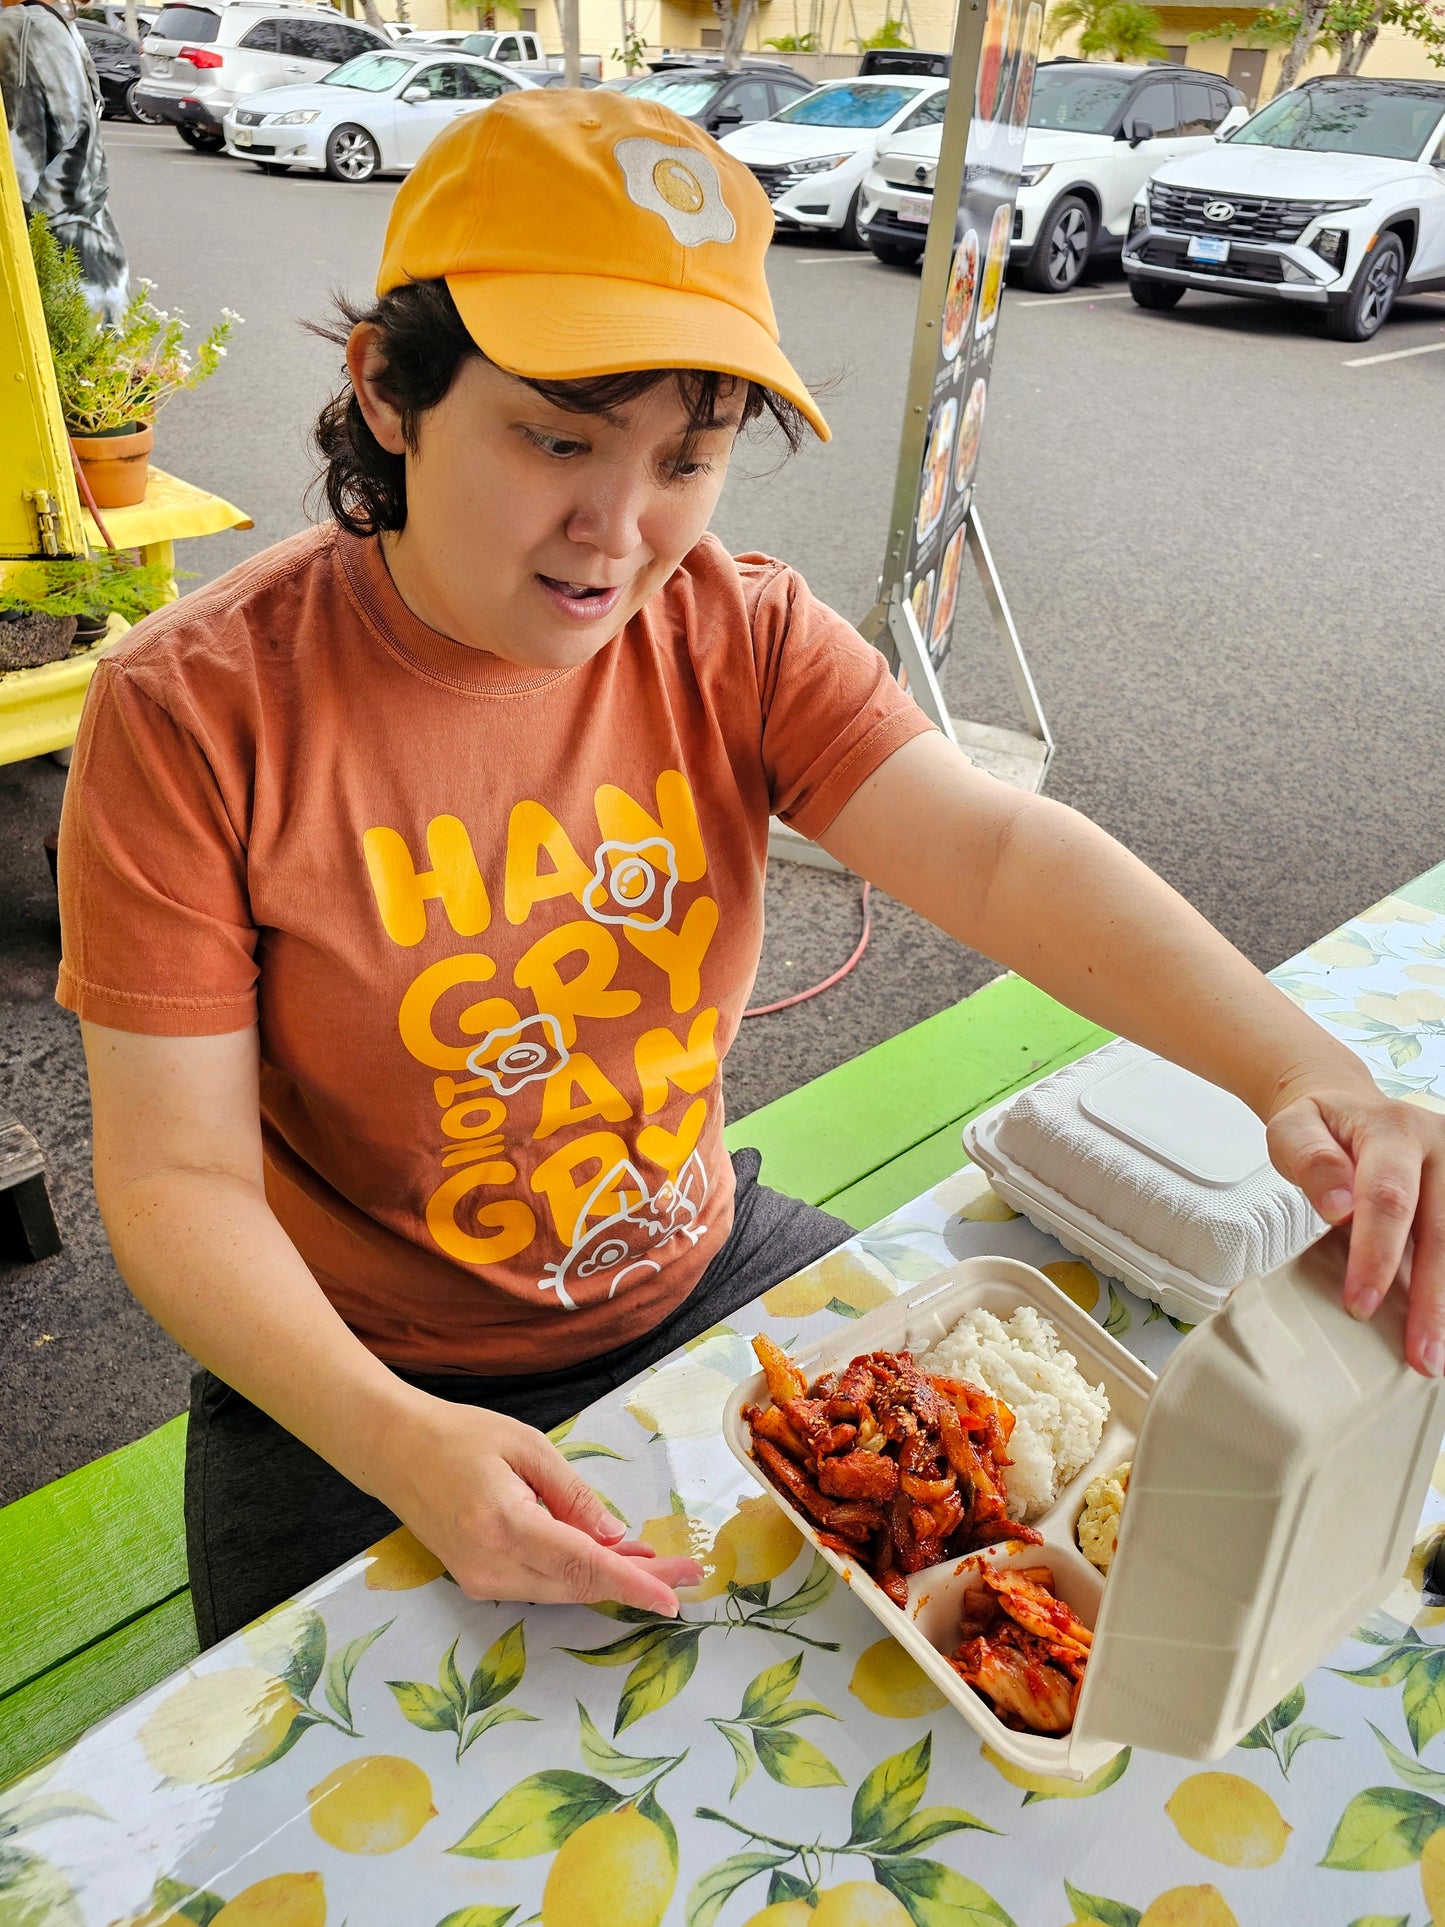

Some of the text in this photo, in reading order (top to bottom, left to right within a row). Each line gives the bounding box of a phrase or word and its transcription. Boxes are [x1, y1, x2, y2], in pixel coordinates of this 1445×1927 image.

[363, 769, 707, 947] HAN
[399, 896, 719, 1072] GRY
[433, 1007, 719, 1168] NOT AN
[426, 1098, 707, 1265] GRY
